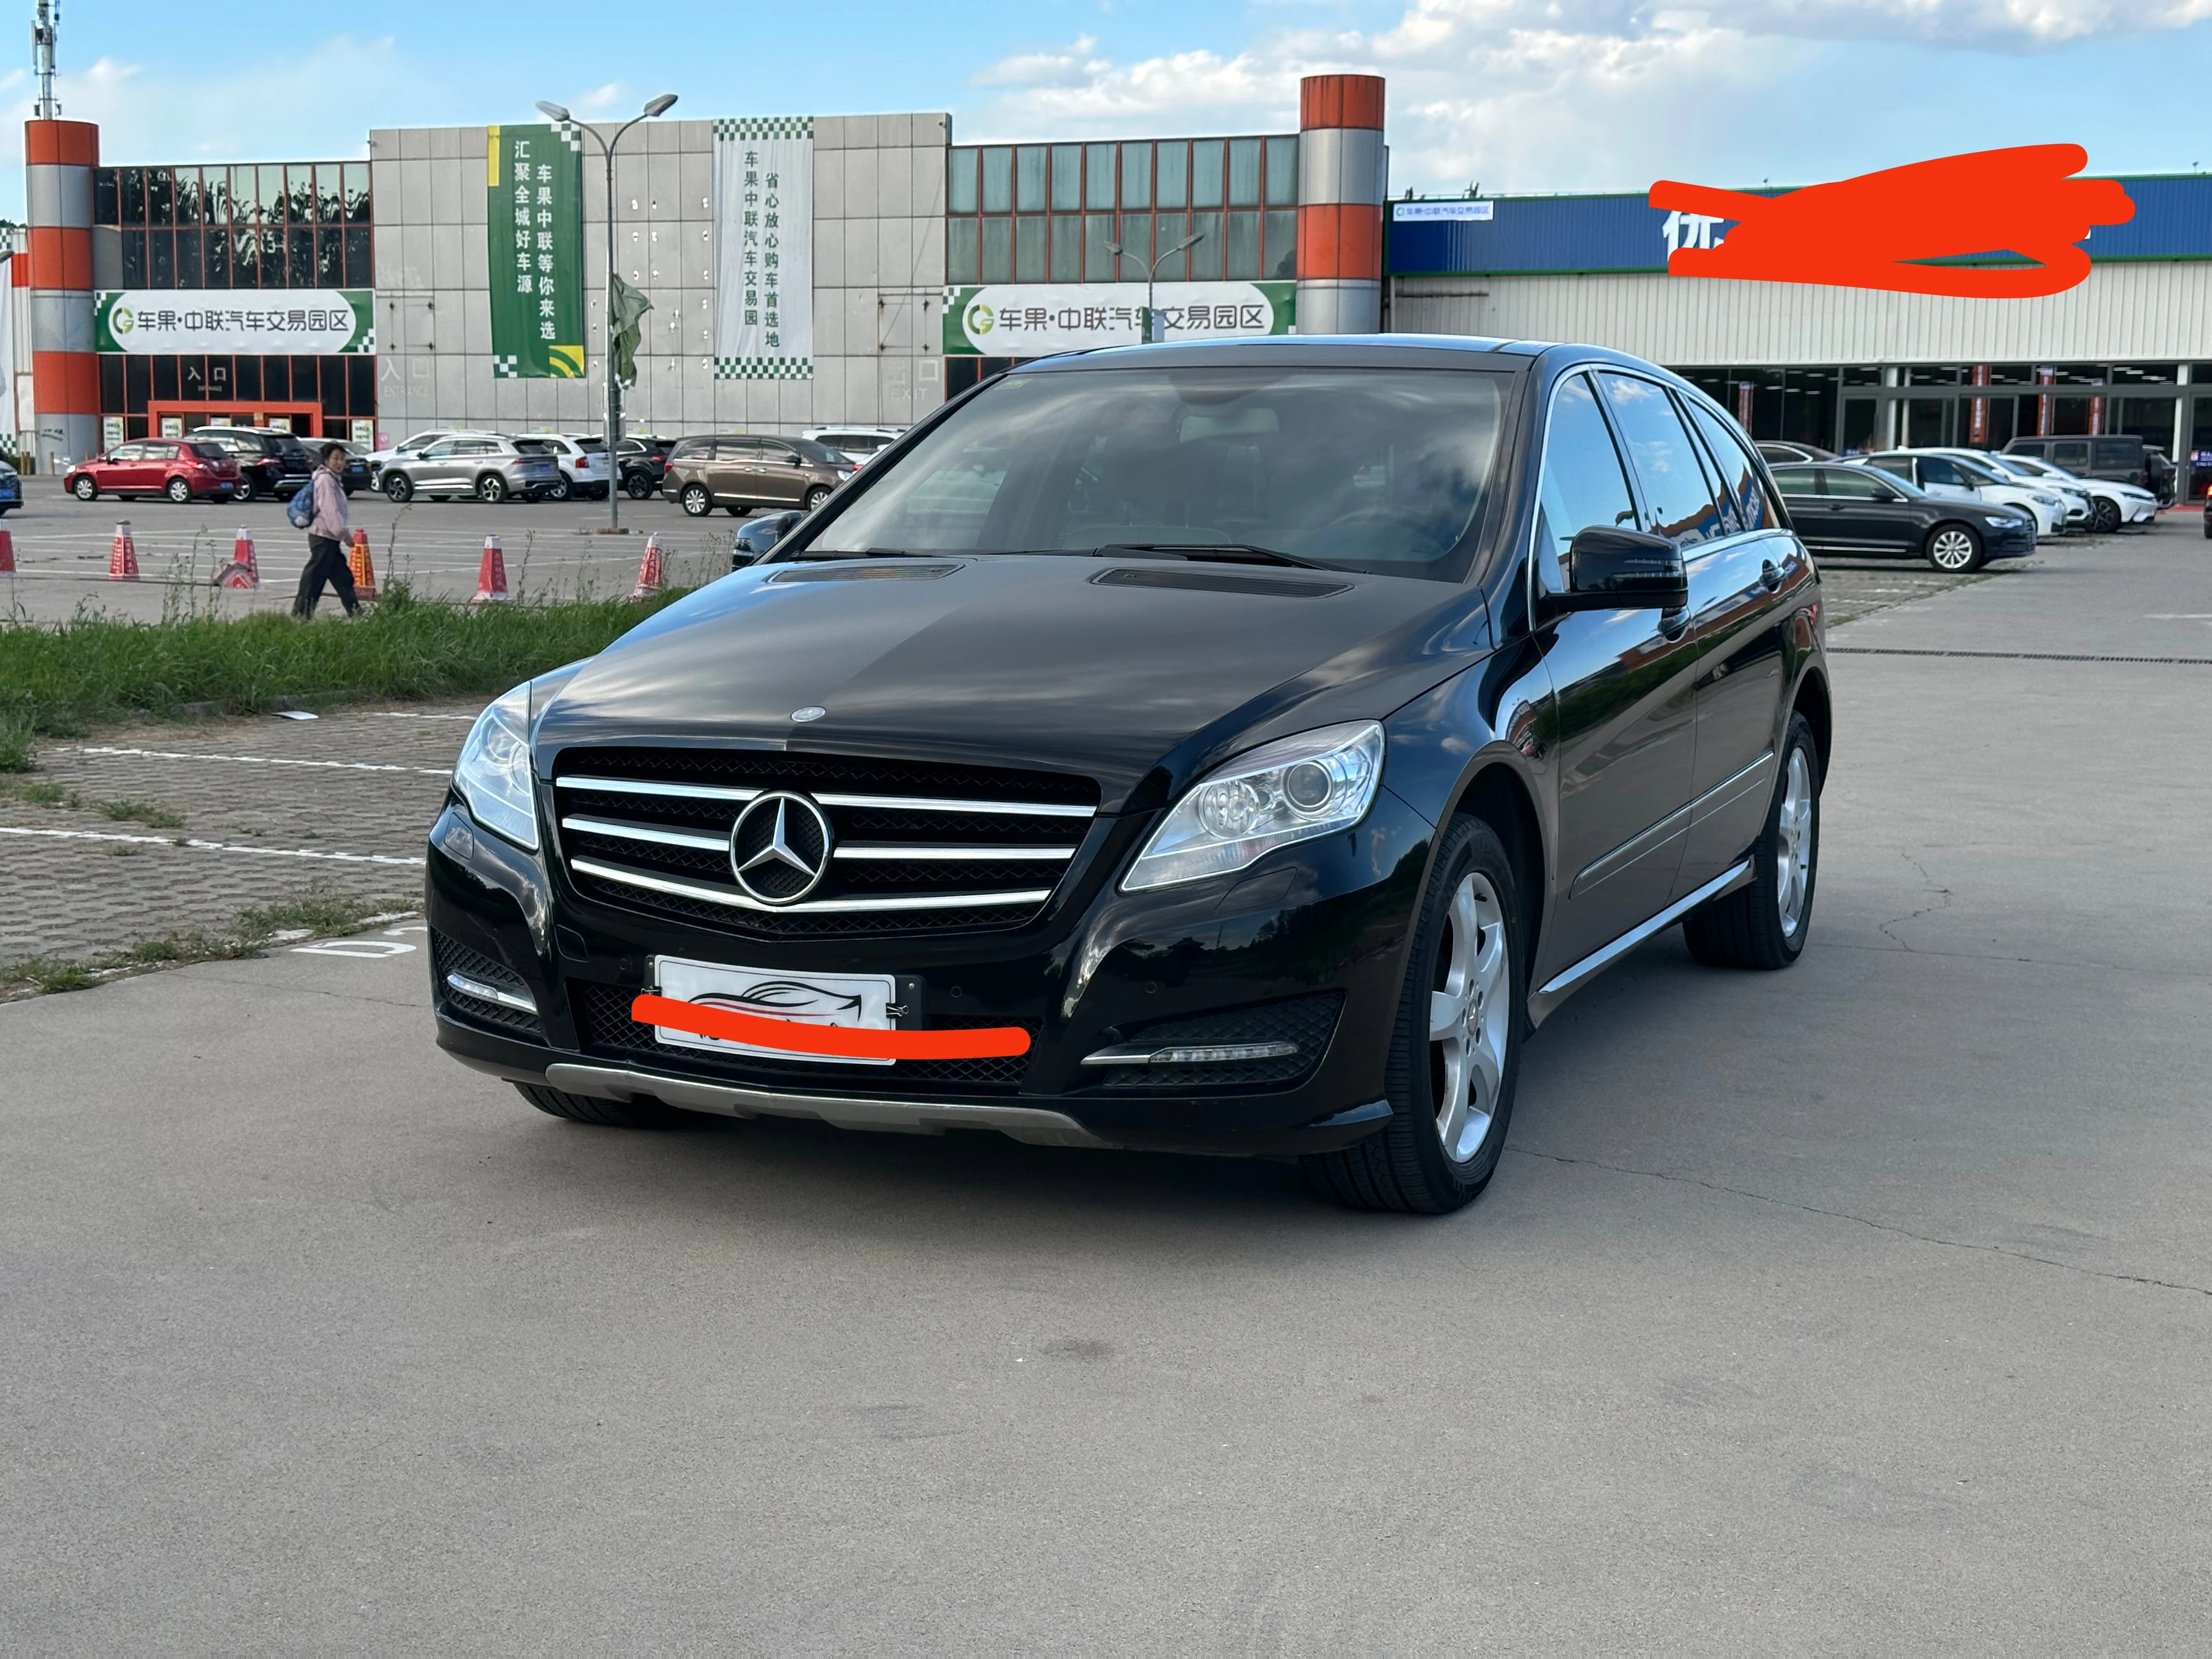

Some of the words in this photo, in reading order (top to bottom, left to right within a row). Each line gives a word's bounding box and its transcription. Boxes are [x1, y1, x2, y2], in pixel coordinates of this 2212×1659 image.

[514, 141, 532, 293] 汇聚全城好车源
[537, 164, 555, 340] 车果中联等你来选
[744, 151, 758, 325] 车果中联汽车交易园
[764, 172, 779, 348] 省心放心购车首选地
[188, 367, 226, 381] 入口
[891, 388, 928, 400] EXIT
